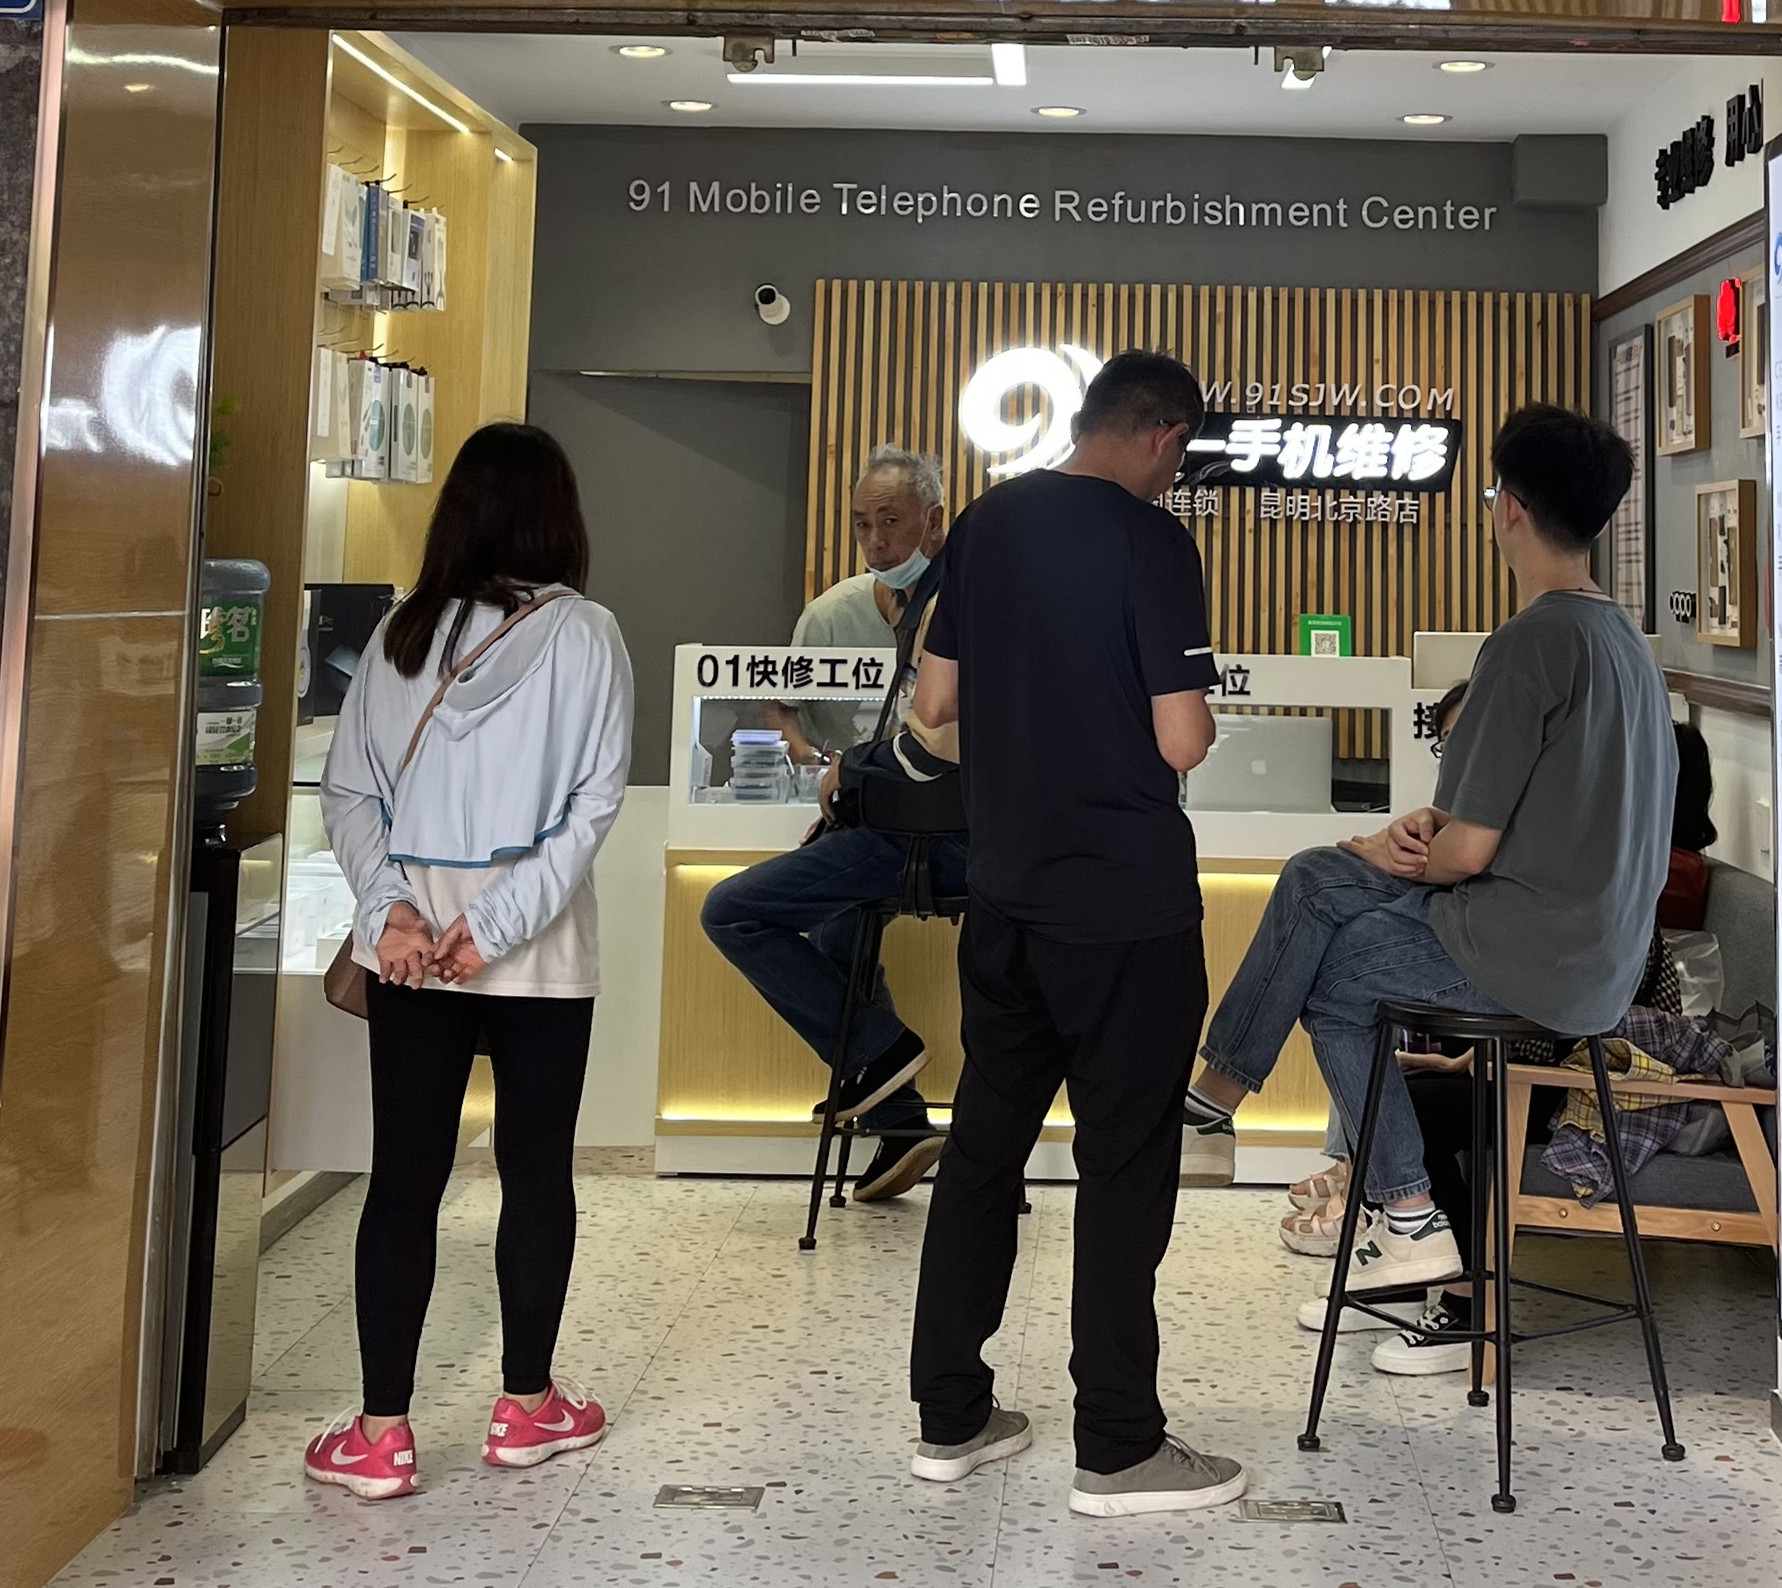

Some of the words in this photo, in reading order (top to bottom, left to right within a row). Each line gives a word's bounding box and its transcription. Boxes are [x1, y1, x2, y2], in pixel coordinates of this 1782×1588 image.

[629, 179, 670, 212] 91
[689, 180, 821, 214] Mobile
[832, 183, 1041, 224] Telephone
[1054, 190, 1349, 228] Refurbishment
[1361, 195, 1498, 231] Center
[1259, 492, 1420, 524] 昆明北京路店
[697, 653, 885, 690] 01快修工位
[393, 1450, 413, 1466] NIKE
